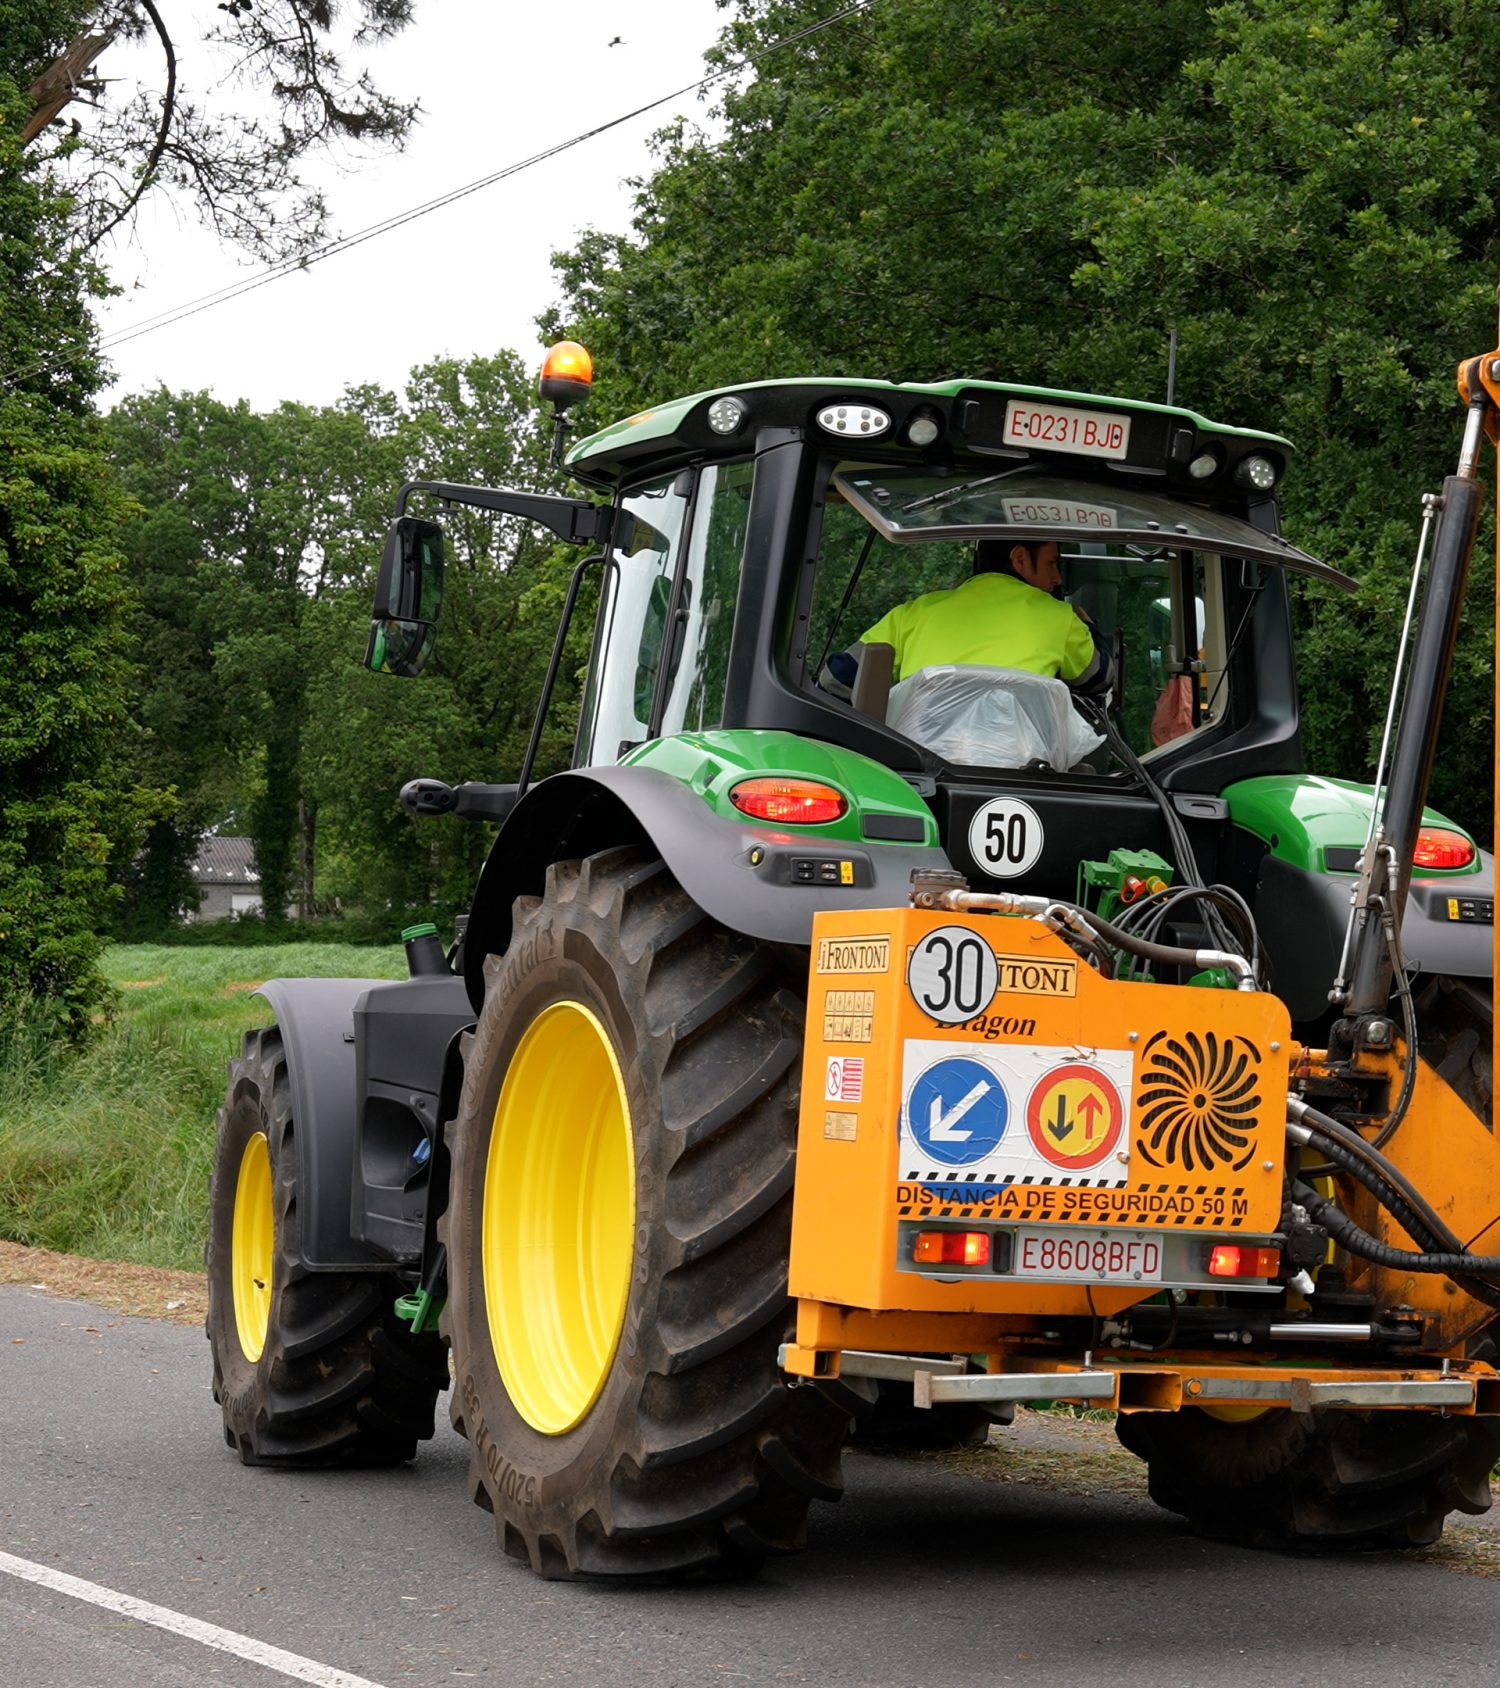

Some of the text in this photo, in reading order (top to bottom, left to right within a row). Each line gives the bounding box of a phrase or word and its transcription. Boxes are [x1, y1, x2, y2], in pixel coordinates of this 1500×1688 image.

[985, 812, 1026, 864] 50
[923, 936, 984, 1013] 30
[896, 1186, 1248, 1215] DISTANCIA DE SEGURIDAD 50 M
[1023, 1238, 1158, 1273] E8608BFD
